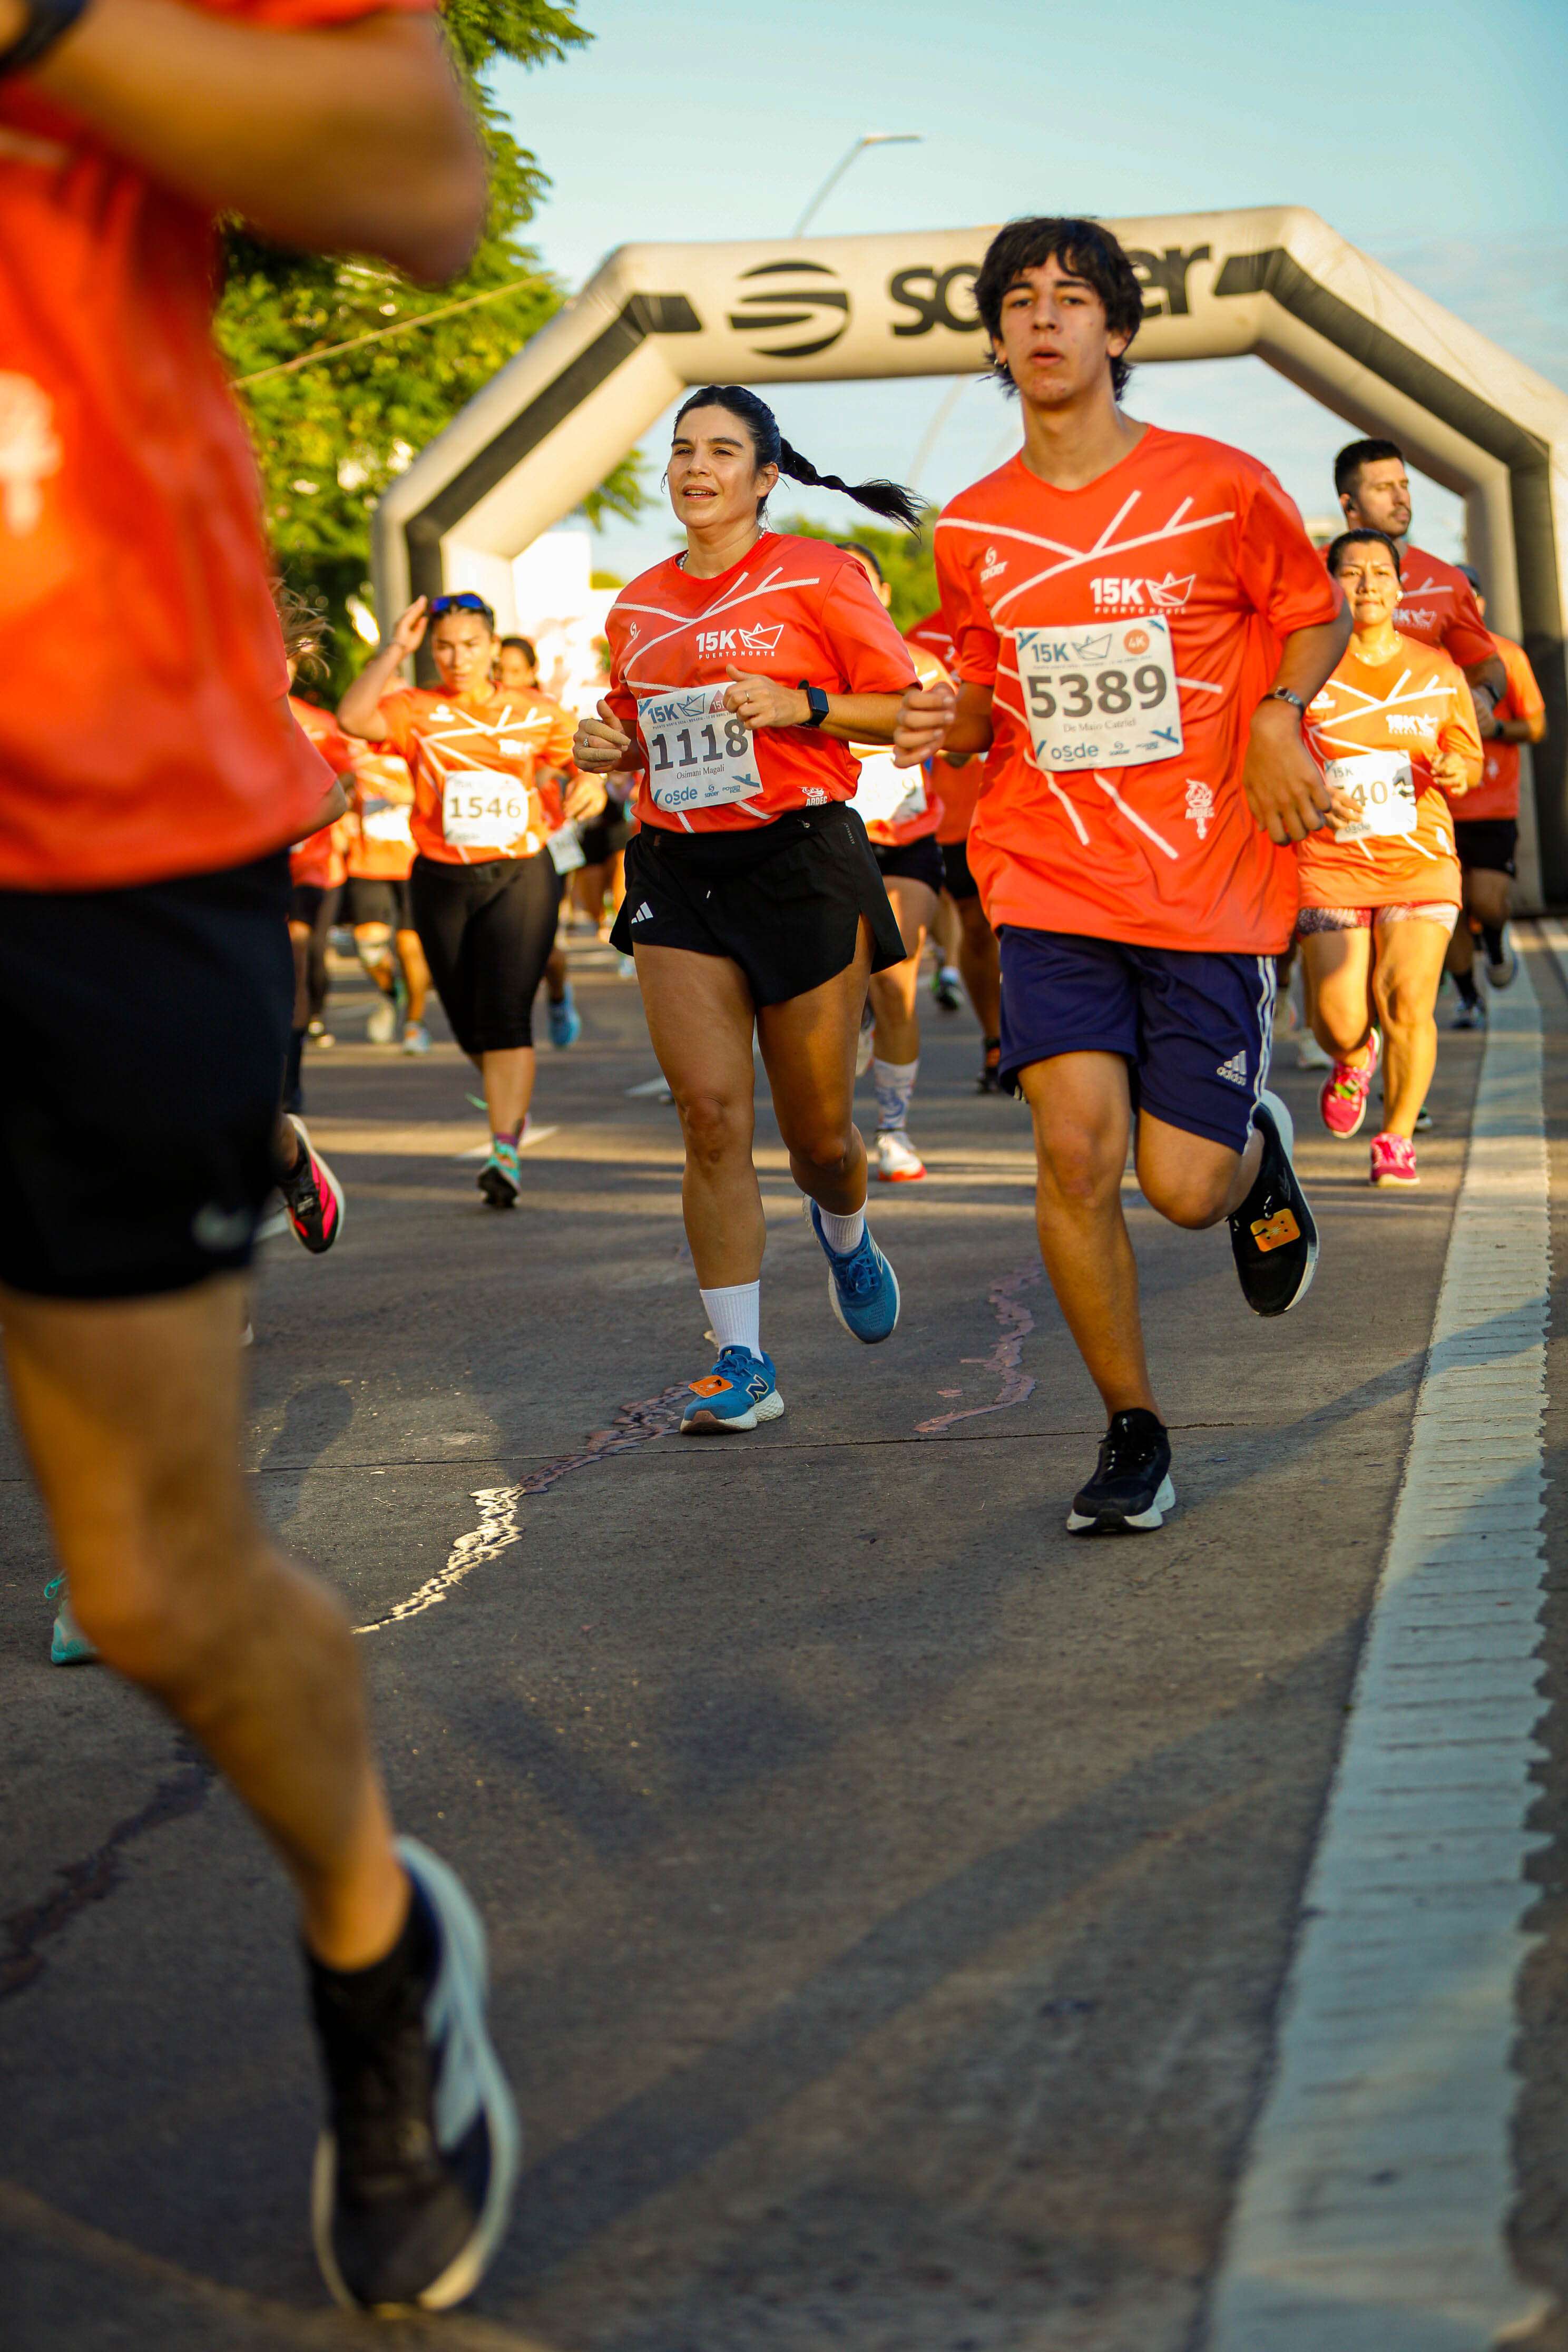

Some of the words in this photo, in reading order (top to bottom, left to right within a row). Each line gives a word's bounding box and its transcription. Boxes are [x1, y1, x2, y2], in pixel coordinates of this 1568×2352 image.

[891, 245, 1210, 336] soer
[1090, 578, 1144, 605] 15K
[1094, 606, 1145, 614] PUERTO
[1149, 606, 1187, 615] NORTE
[696, 629, 737, 652] 15K
[1128, 635, 1146, 648] 4K
[699, 651, 737, 660] PUERTO
[1031, 642, 1070, 662] 15K
[1027, 665, 1167, 718] 5389
[648, 703, 679, 724] 15K
[652, 719, 748, 771] 1118
[1051, 742, 1099, 761] osde
[677, 768, 701, 779] Osimani
[703, 764, 724, 776] Magali
[664, 786, 698, 805] osde
[806, 796, 828, 807] ARDEC
[449, 796, 521, 819] 1546
[1217, 1066, 1247, 1086] adidas
